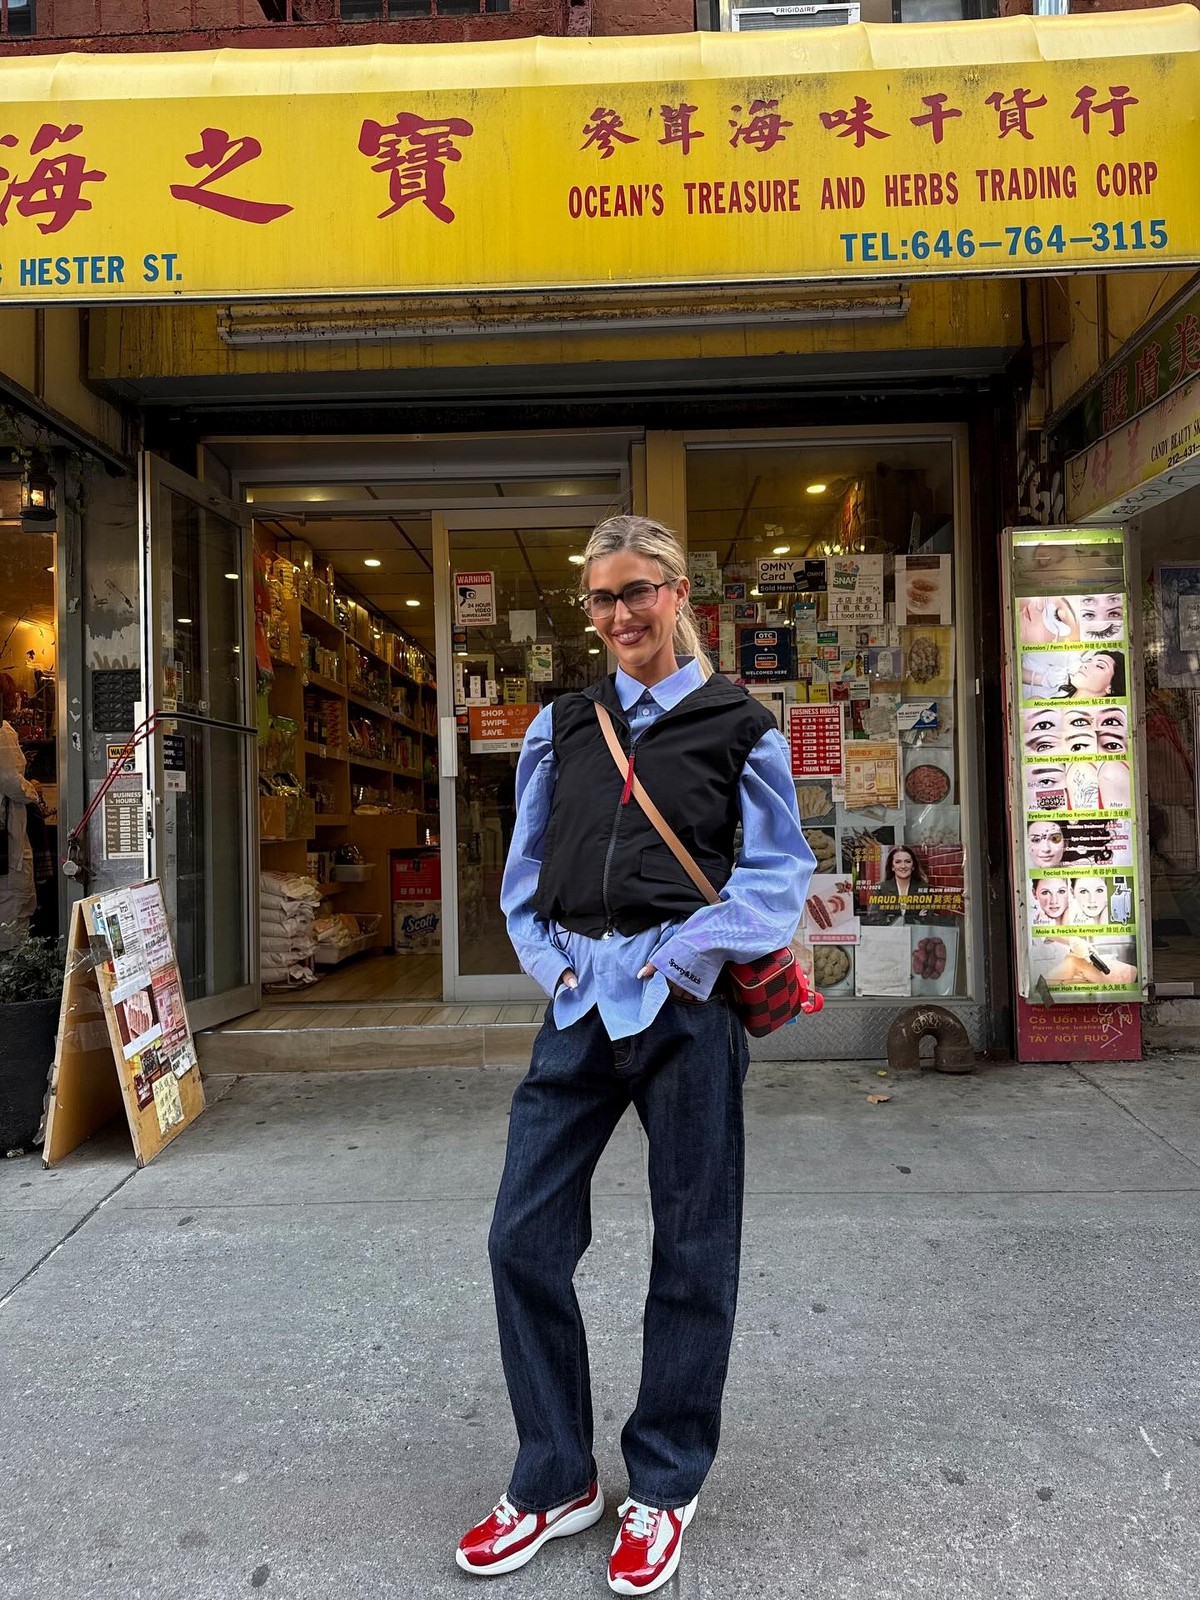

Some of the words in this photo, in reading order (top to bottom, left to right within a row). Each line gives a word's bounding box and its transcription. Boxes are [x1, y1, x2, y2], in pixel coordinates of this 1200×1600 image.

[775, 6, 816, 14] FRIGIDAIRE
[568, 183, 664, 219] OCEAN'S
[683, 179, 800, 214] TREASURE
[821, 175, 865, 210] AND
[884, 171, 958, 208] HERBS
[976, 165, 1077, 203] TRADING
[1096, 161, 1158, 197] CORP
[20, 255, 124, 286] HESTER
[143, 253, 182, 282] ST.
[1151, 437, 1168, 463] CANDY
[1170, 424, 1192, 450] BEAUTY
[760, 562, 794, 571] OMNY
[456, 574, 491, 584] WARNING
[760, 572, 786, 581] Card
[833, 577, 857, 585] SNAP
[855, 612, 874, 620] stamp
[480, 709, 505, 717] SHOP.
[481, 719, 510, 727] SWIPE.
[481, 728, 505, 736] SAVE.
[869, 895, 896, 904] MAUD
[898, 895, 933, 904] MARON
[406, 913, 433, 933] Scott
